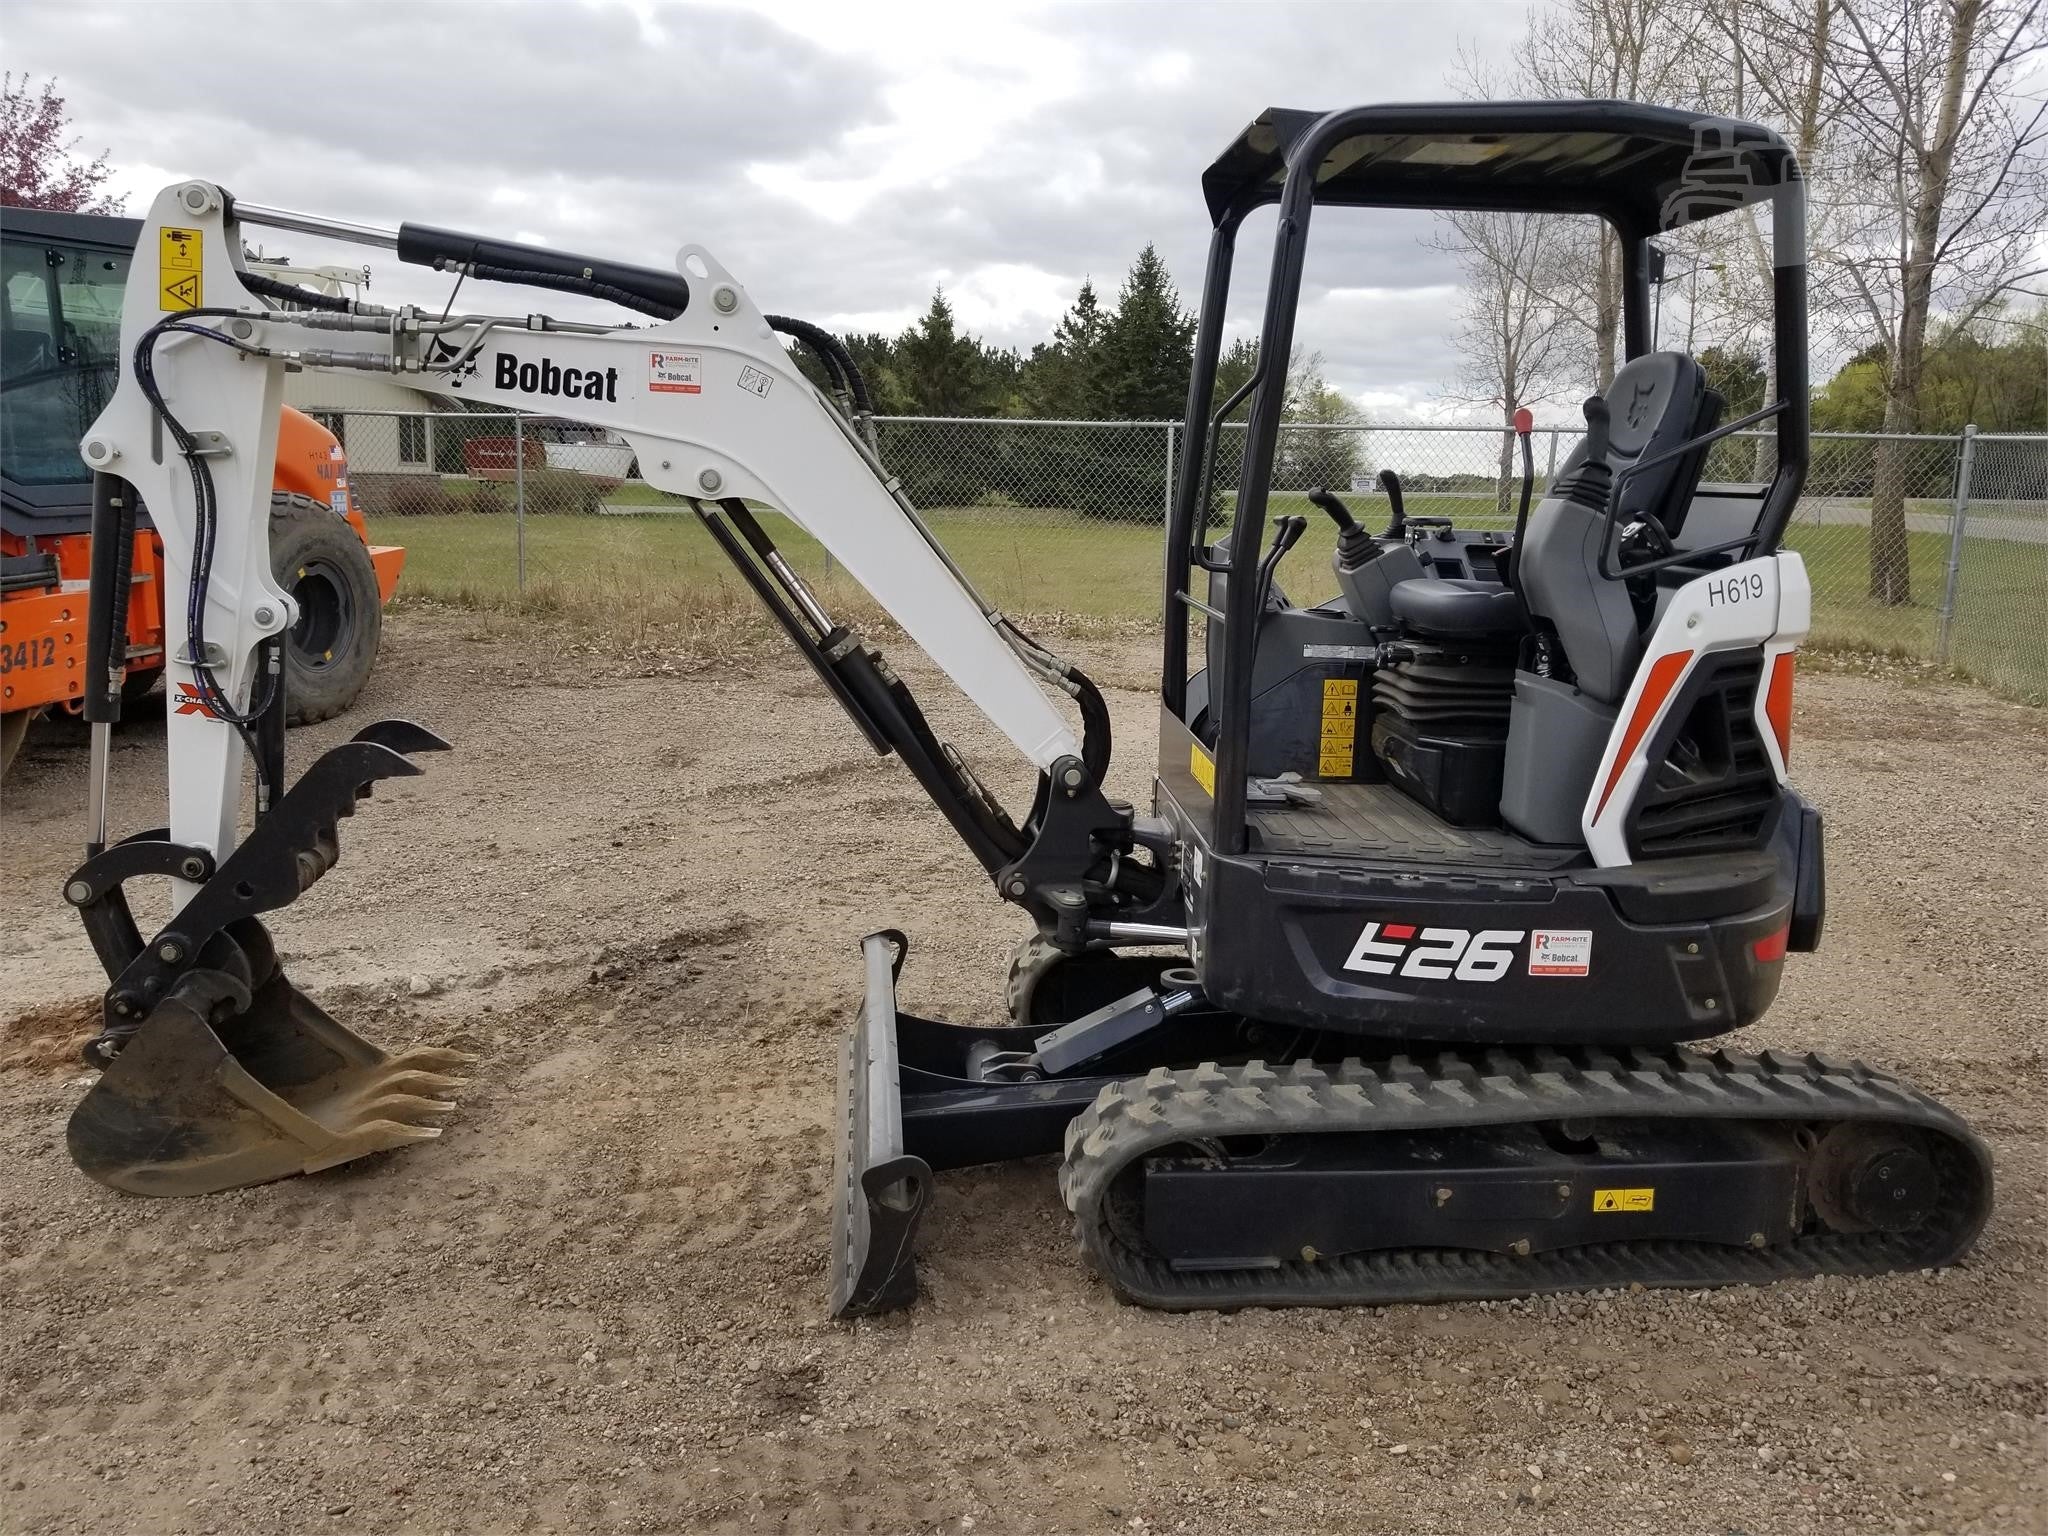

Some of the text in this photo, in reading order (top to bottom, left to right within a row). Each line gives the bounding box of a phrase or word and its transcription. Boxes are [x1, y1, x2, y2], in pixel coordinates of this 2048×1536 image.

[665, 355, 699, 363] FARM-RITE
[494, 352, 618, 403] Bobcat
[667, 372, 692, 382] Bobcat
[1708, 573, 1763, 607] H619
[0, 636, 55, 674] 3412
[1343, 921, 1526, 982] E26
[1551, 953, 1578, 962] Bobcat
